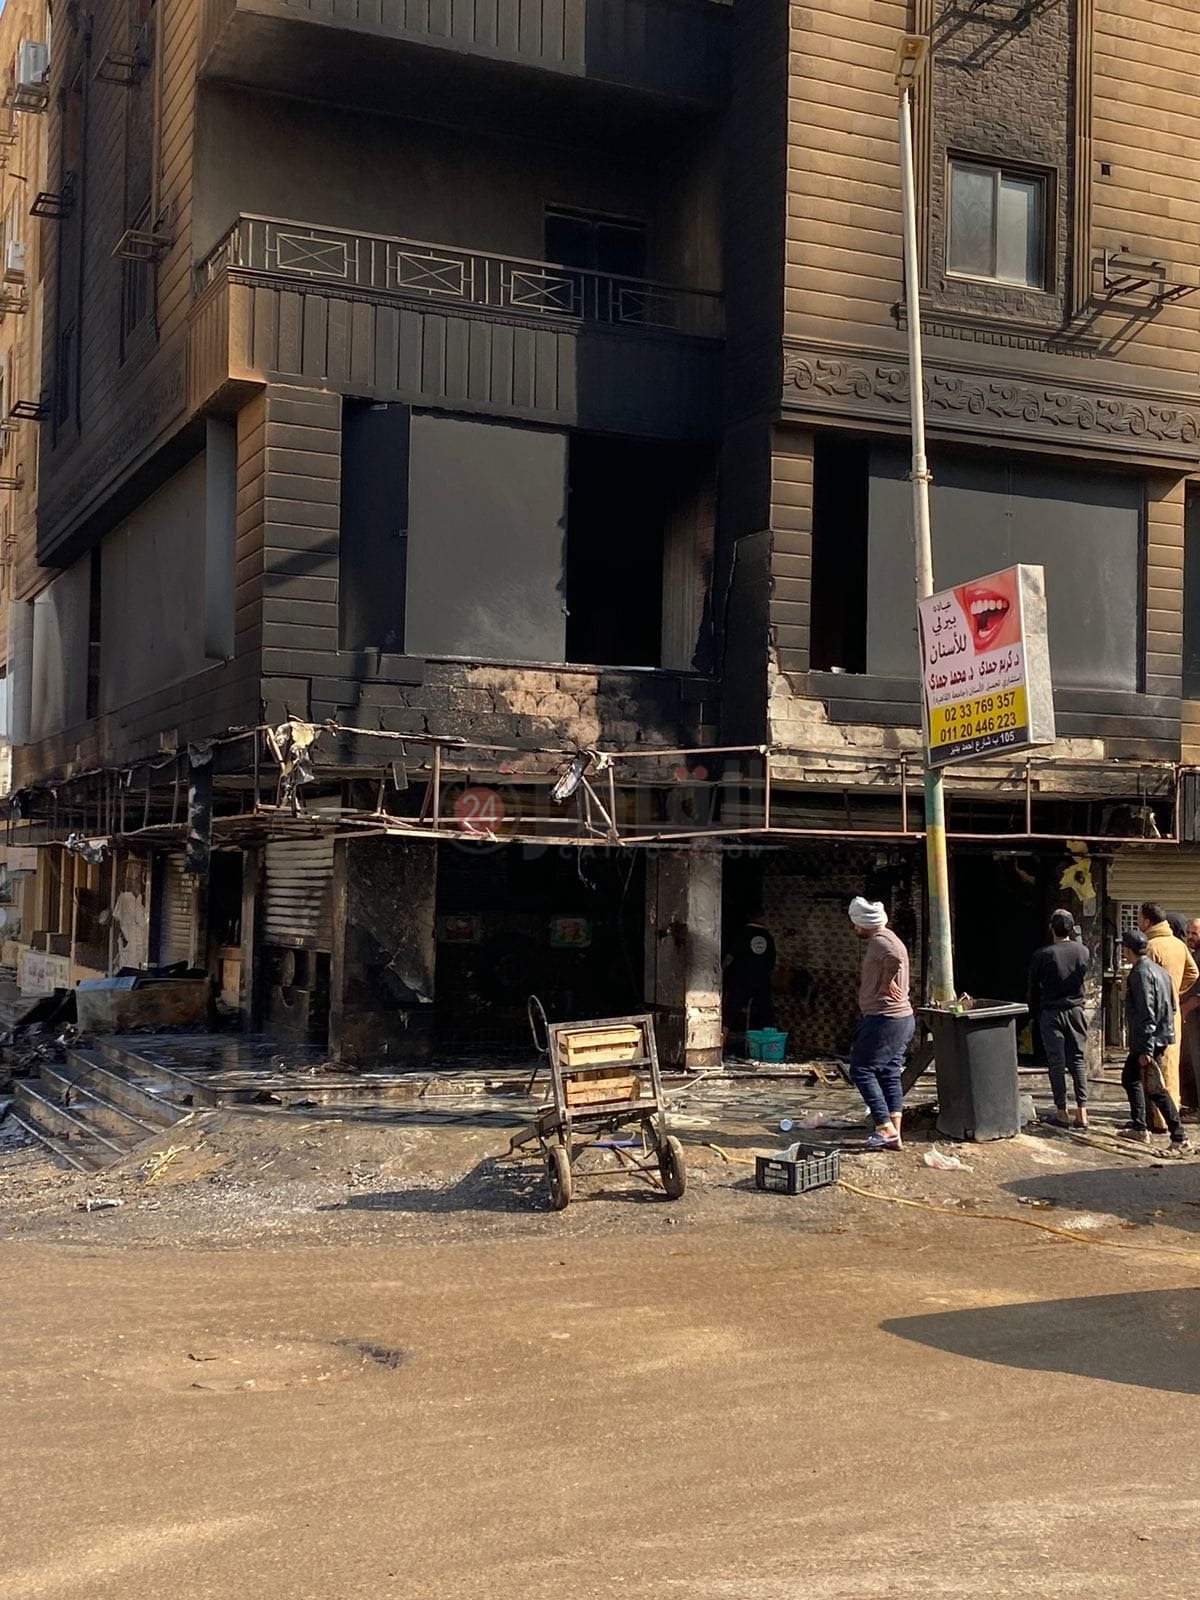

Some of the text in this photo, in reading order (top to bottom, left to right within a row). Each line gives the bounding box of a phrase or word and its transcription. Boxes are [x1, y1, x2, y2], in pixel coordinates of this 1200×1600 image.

[932, 616, 956, 636] بيرلي
[930, 632, 967, 664] للأسنان
[999, 651, 1012, 673] كريم
[950, 670, 966, 685] محمد
[945, 691, 1015, 722] 02 33 769 357
[940, 712, 1016, 742] 011 20 446 223
[1000, 731, 1015, 744] 105
[975, 736, 992, 752] شارع
